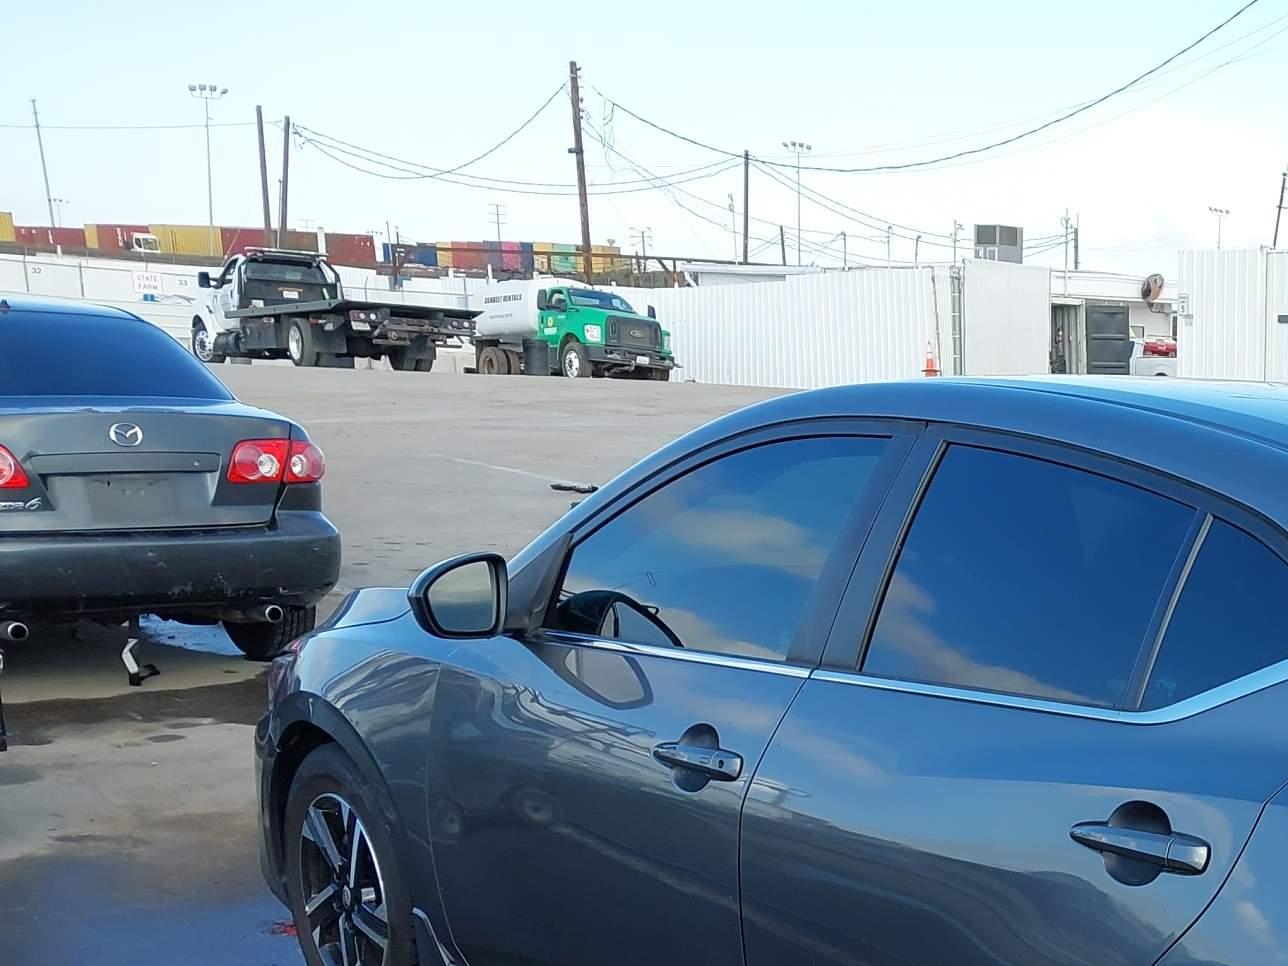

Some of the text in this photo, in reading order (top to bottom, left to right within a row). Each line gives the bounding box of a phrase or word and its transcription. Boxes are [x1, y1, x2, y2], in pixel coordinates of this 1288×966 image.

[31, 267, 42, 275] 32
[136, 274, 157, 283] STATE
[138, 283, 158, 291] FARM
[177, 279, 188, 287] 33
